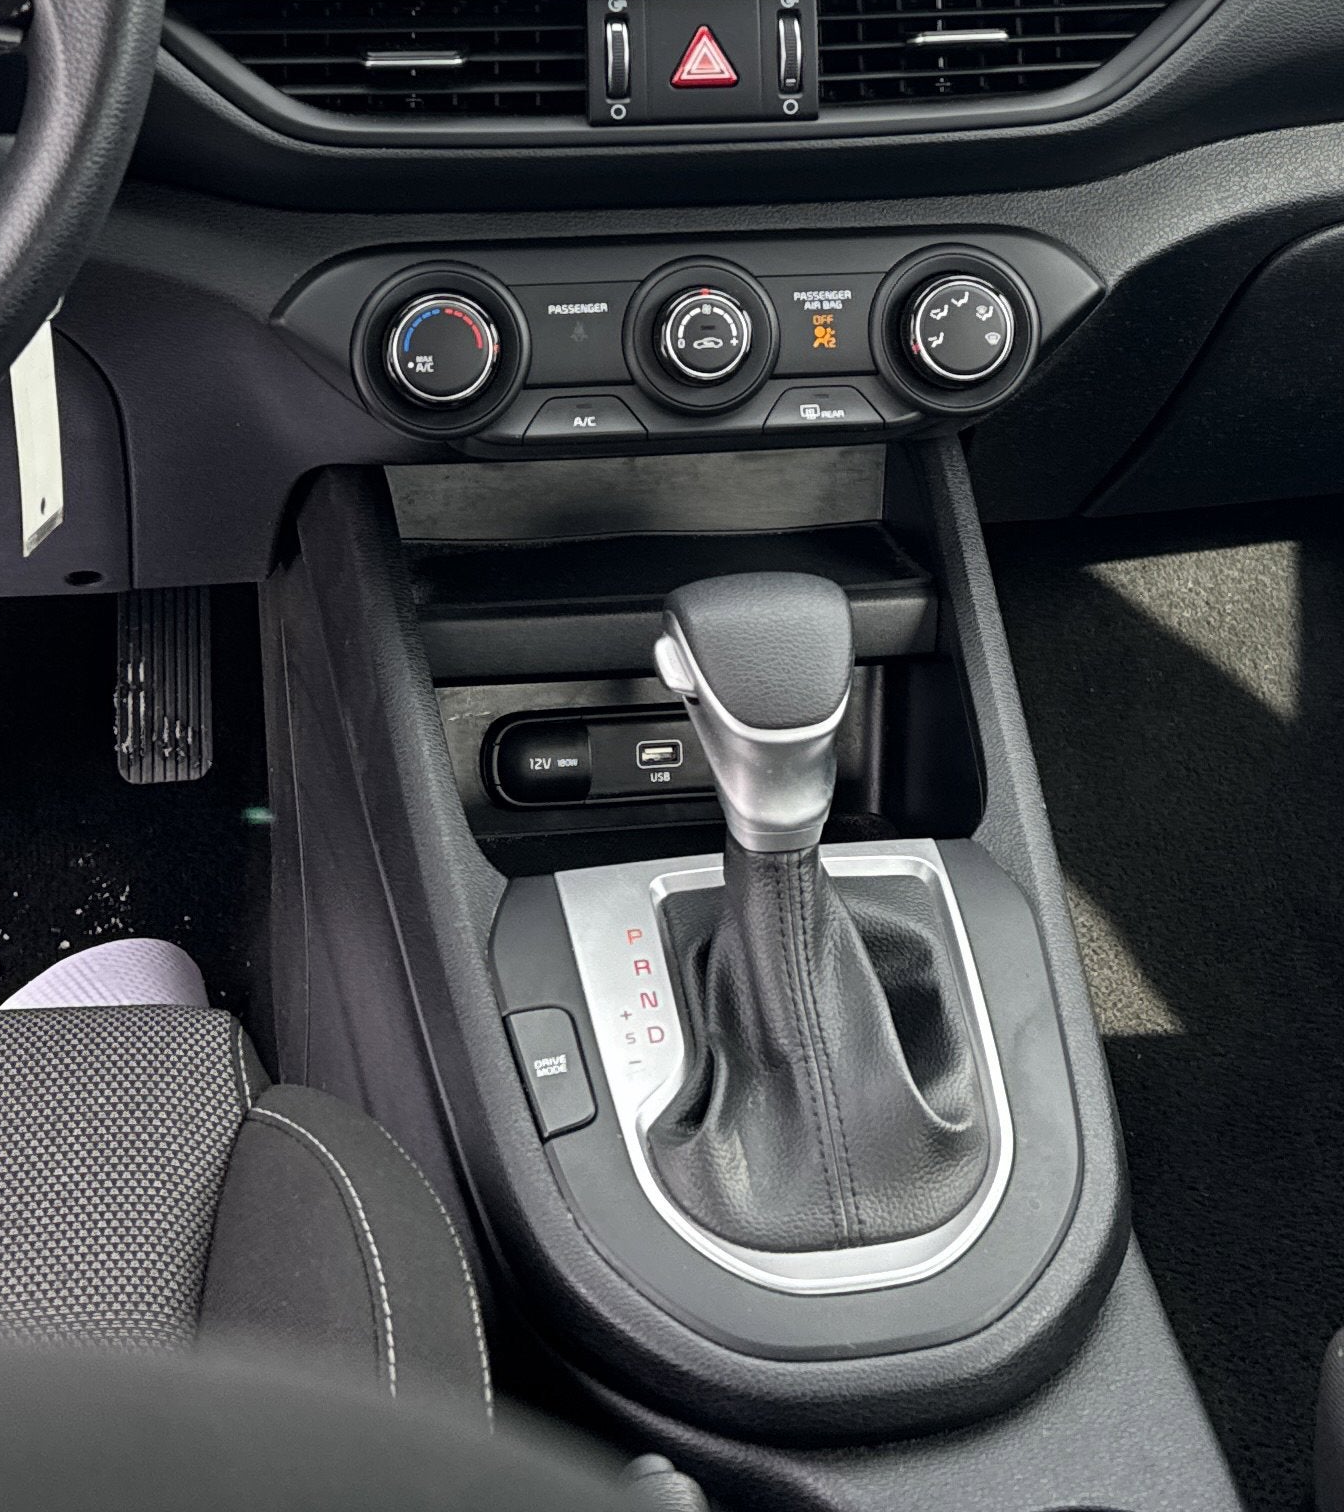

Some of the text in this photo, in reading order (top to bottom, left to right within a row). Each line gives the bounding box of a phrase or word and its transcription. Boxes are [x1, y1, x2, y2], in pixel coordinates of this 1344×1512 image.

[793, 289, 852, 302] PASSENGER
[547, 302, 609, 315] PASSENGER
[803, 299, 843, 311] AIR BAG
[812, 314, 834, 326] OFF
[415, 361, 434, 373] A/C
[820, 409, 845, 419] REAR
[572, 416, 597, 428] A/C
[529, 757, 552, 771] 12V
[650, 771, 671, 783] USB
[626, 928, 643, 945] P
[633, 959, 652, 976] R
[639, 990, 659, 1008] N
[646, 1025, 665, 1044] D
[534, 1054, 567, 1069] DRIVE
[536, 1063, 567, 1078] MODE
